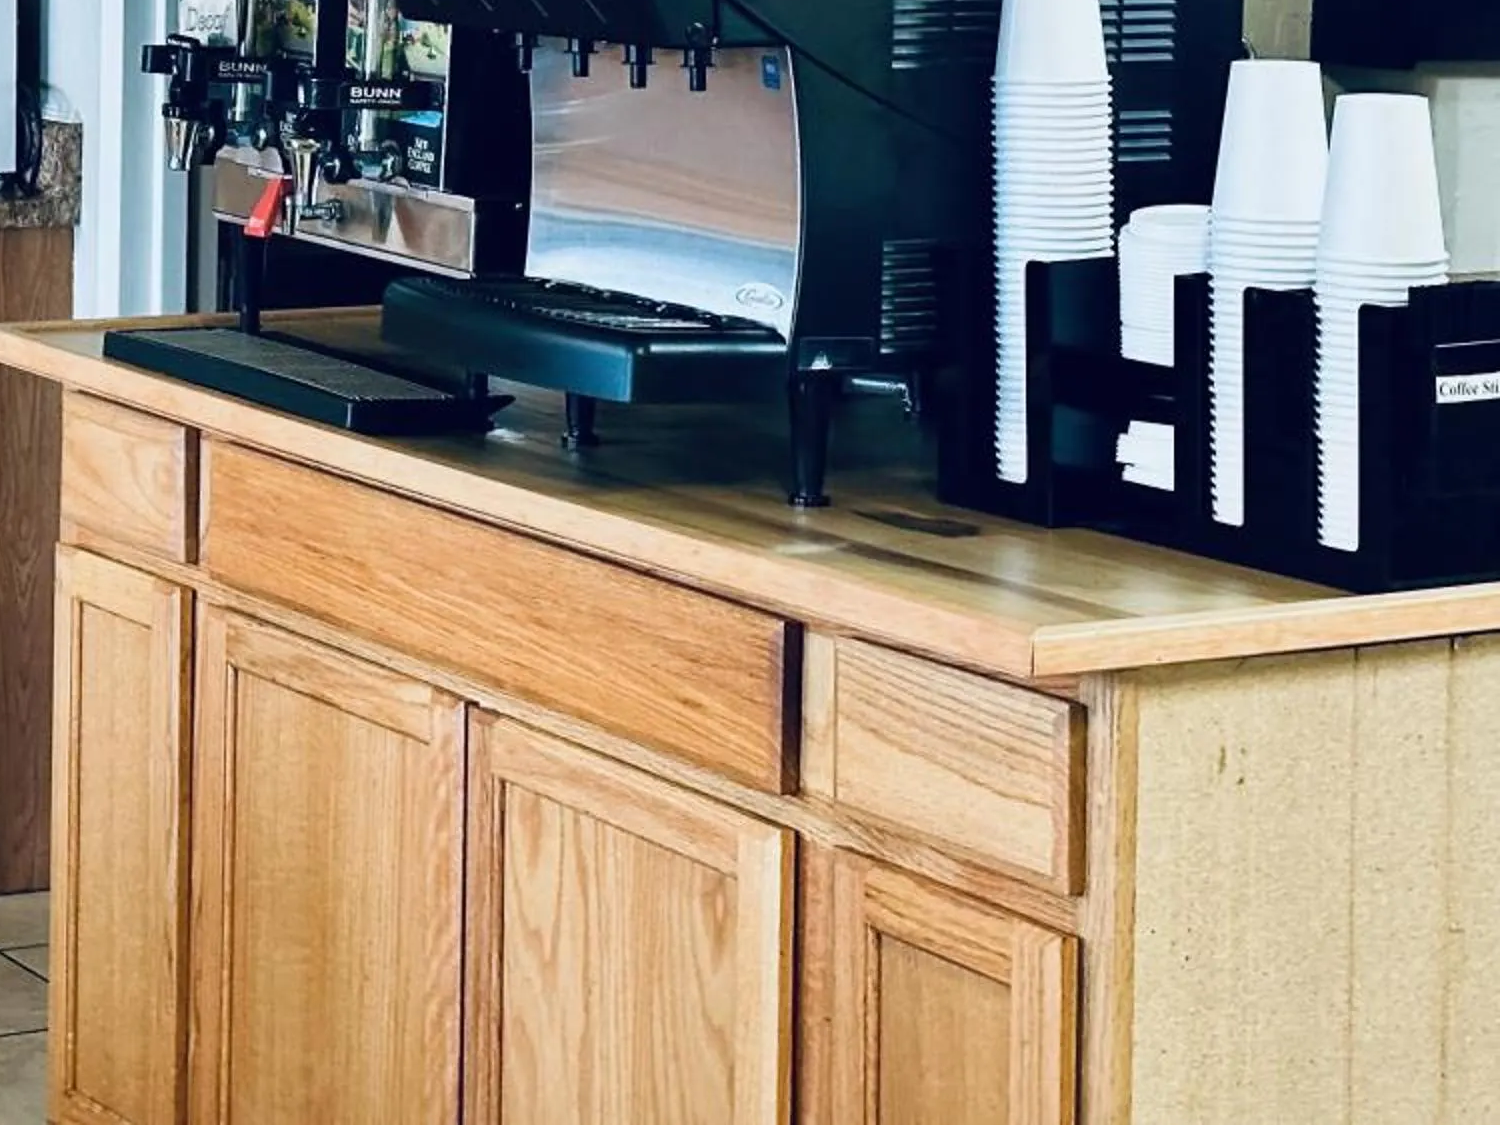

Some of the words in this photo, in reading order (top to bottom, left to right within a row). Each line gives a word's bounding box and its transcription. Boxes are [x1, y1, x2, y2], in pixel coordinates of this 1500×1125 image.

[218, 60, 268, 73] BUNN
[350, 86, 402, 98] BUNN
[1440, 381, 1479, 396] Coffee
